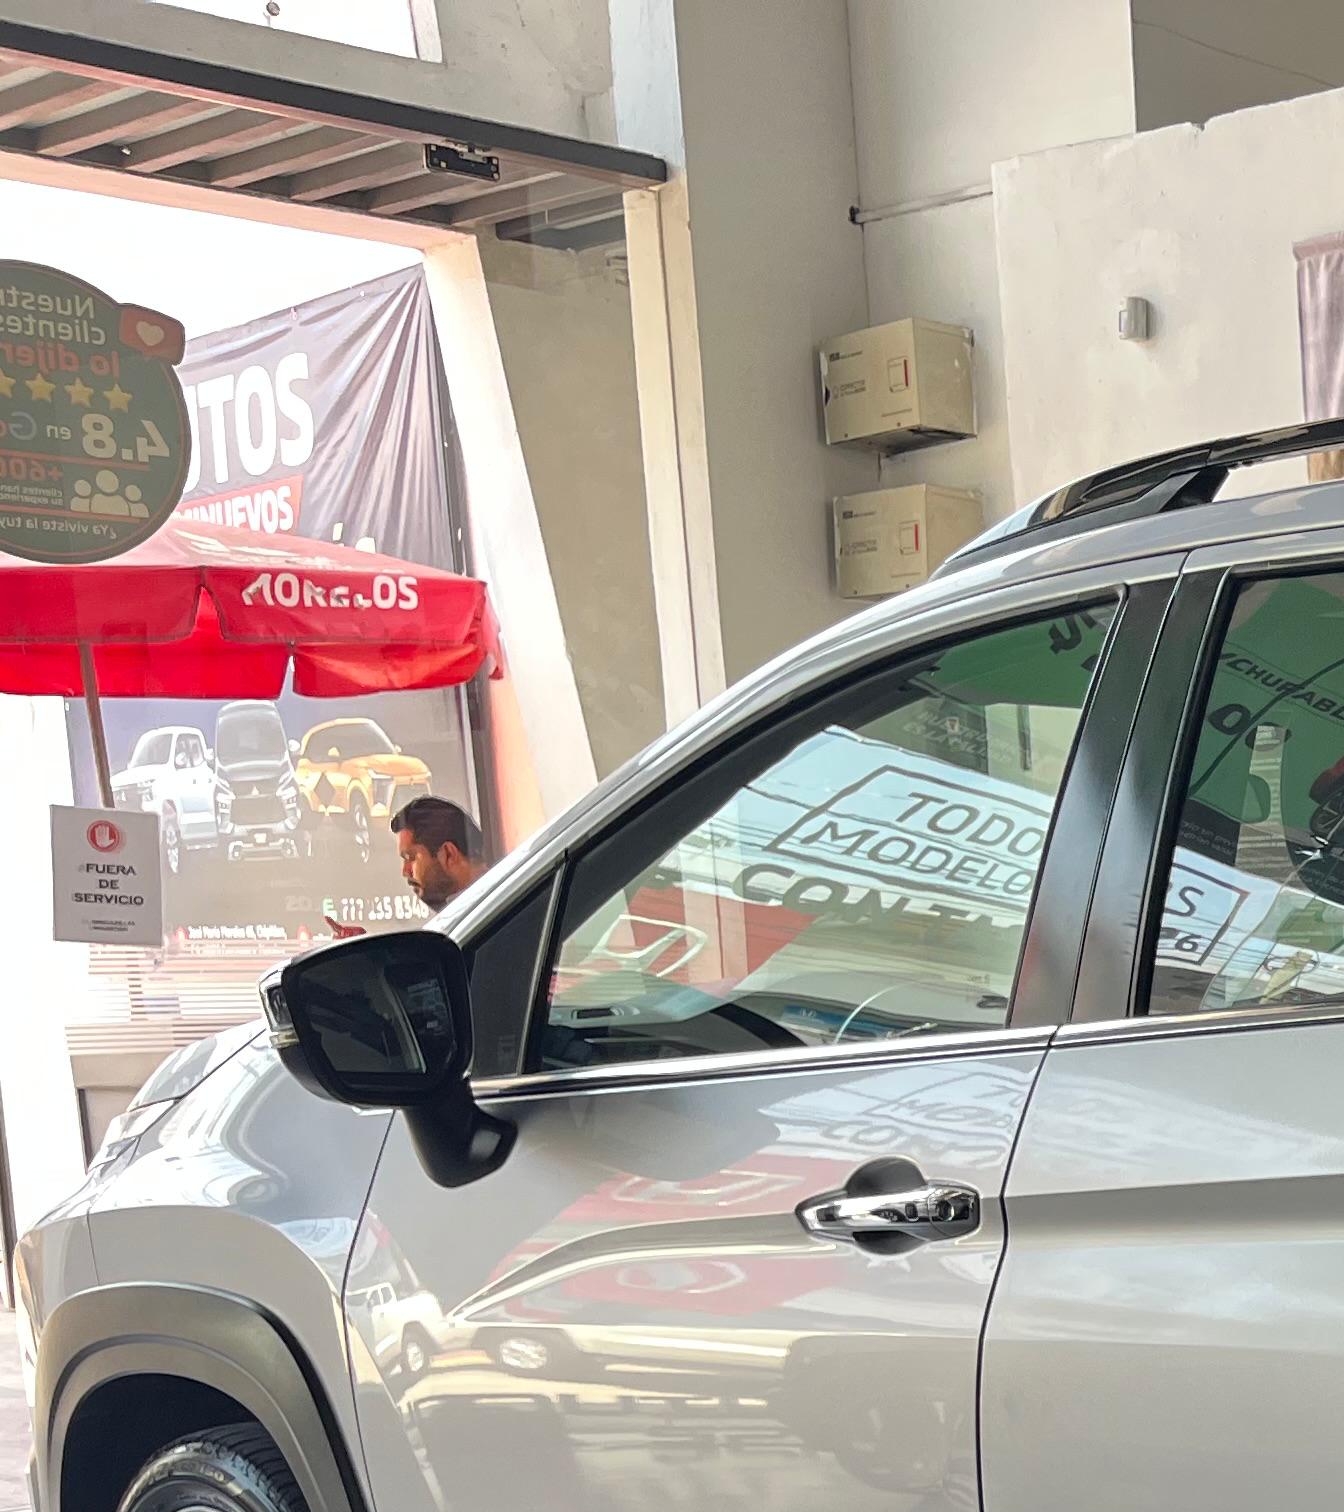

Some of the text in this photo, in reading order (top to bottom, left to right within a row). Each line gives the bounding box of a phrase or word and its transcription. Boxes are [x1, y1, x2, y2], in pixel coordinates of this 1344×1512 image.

[896, 791, 1046, 857] TODO
[800, 820, 1035, 896] MODELO
[86, 863, 137, 876] FUERA
[98, 879, 119, 890] DE
[74, 892, 144, 906] SERVICIO
